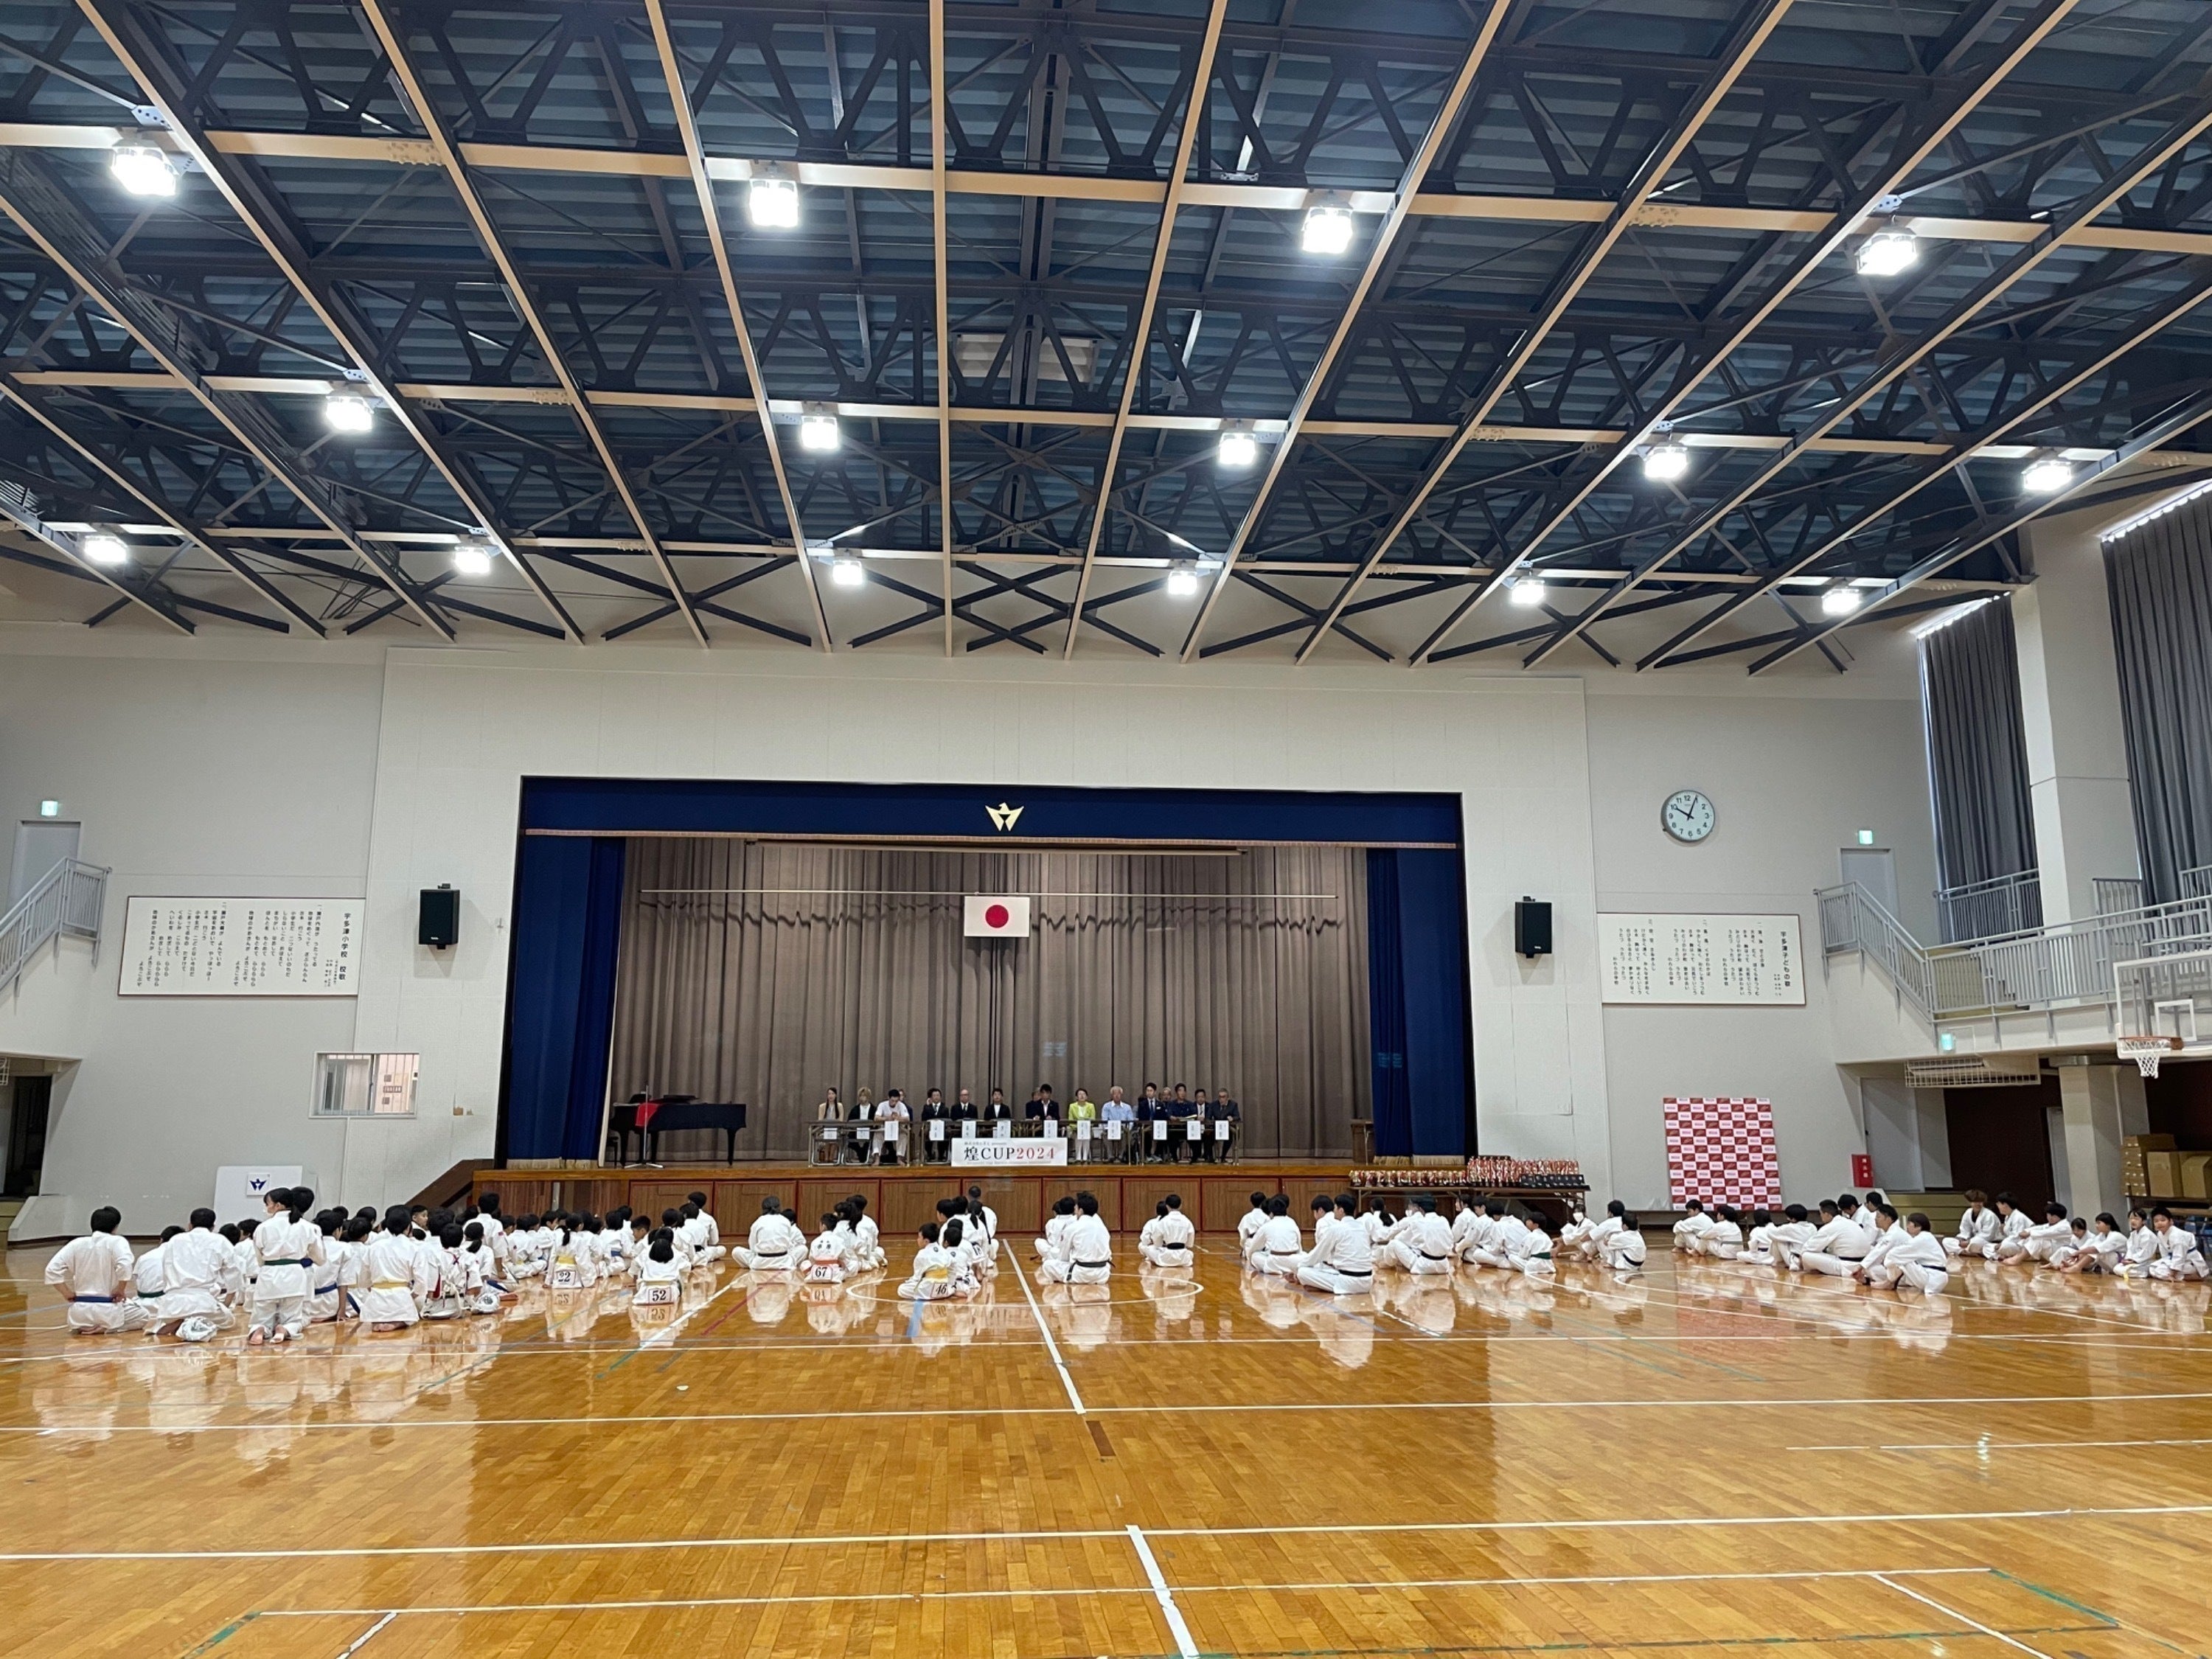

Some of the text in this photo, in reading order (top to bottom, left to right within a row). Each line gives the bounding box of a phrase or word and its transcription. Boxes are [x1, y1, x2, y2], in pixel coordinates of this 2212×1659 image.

[964, 1146, 1054, 1161] 煌CUP2024
[558, 1271, 571, 1282] 22
[815, 1267, 827, 1278] 67
[652, 1290, 667, 1301] 52
